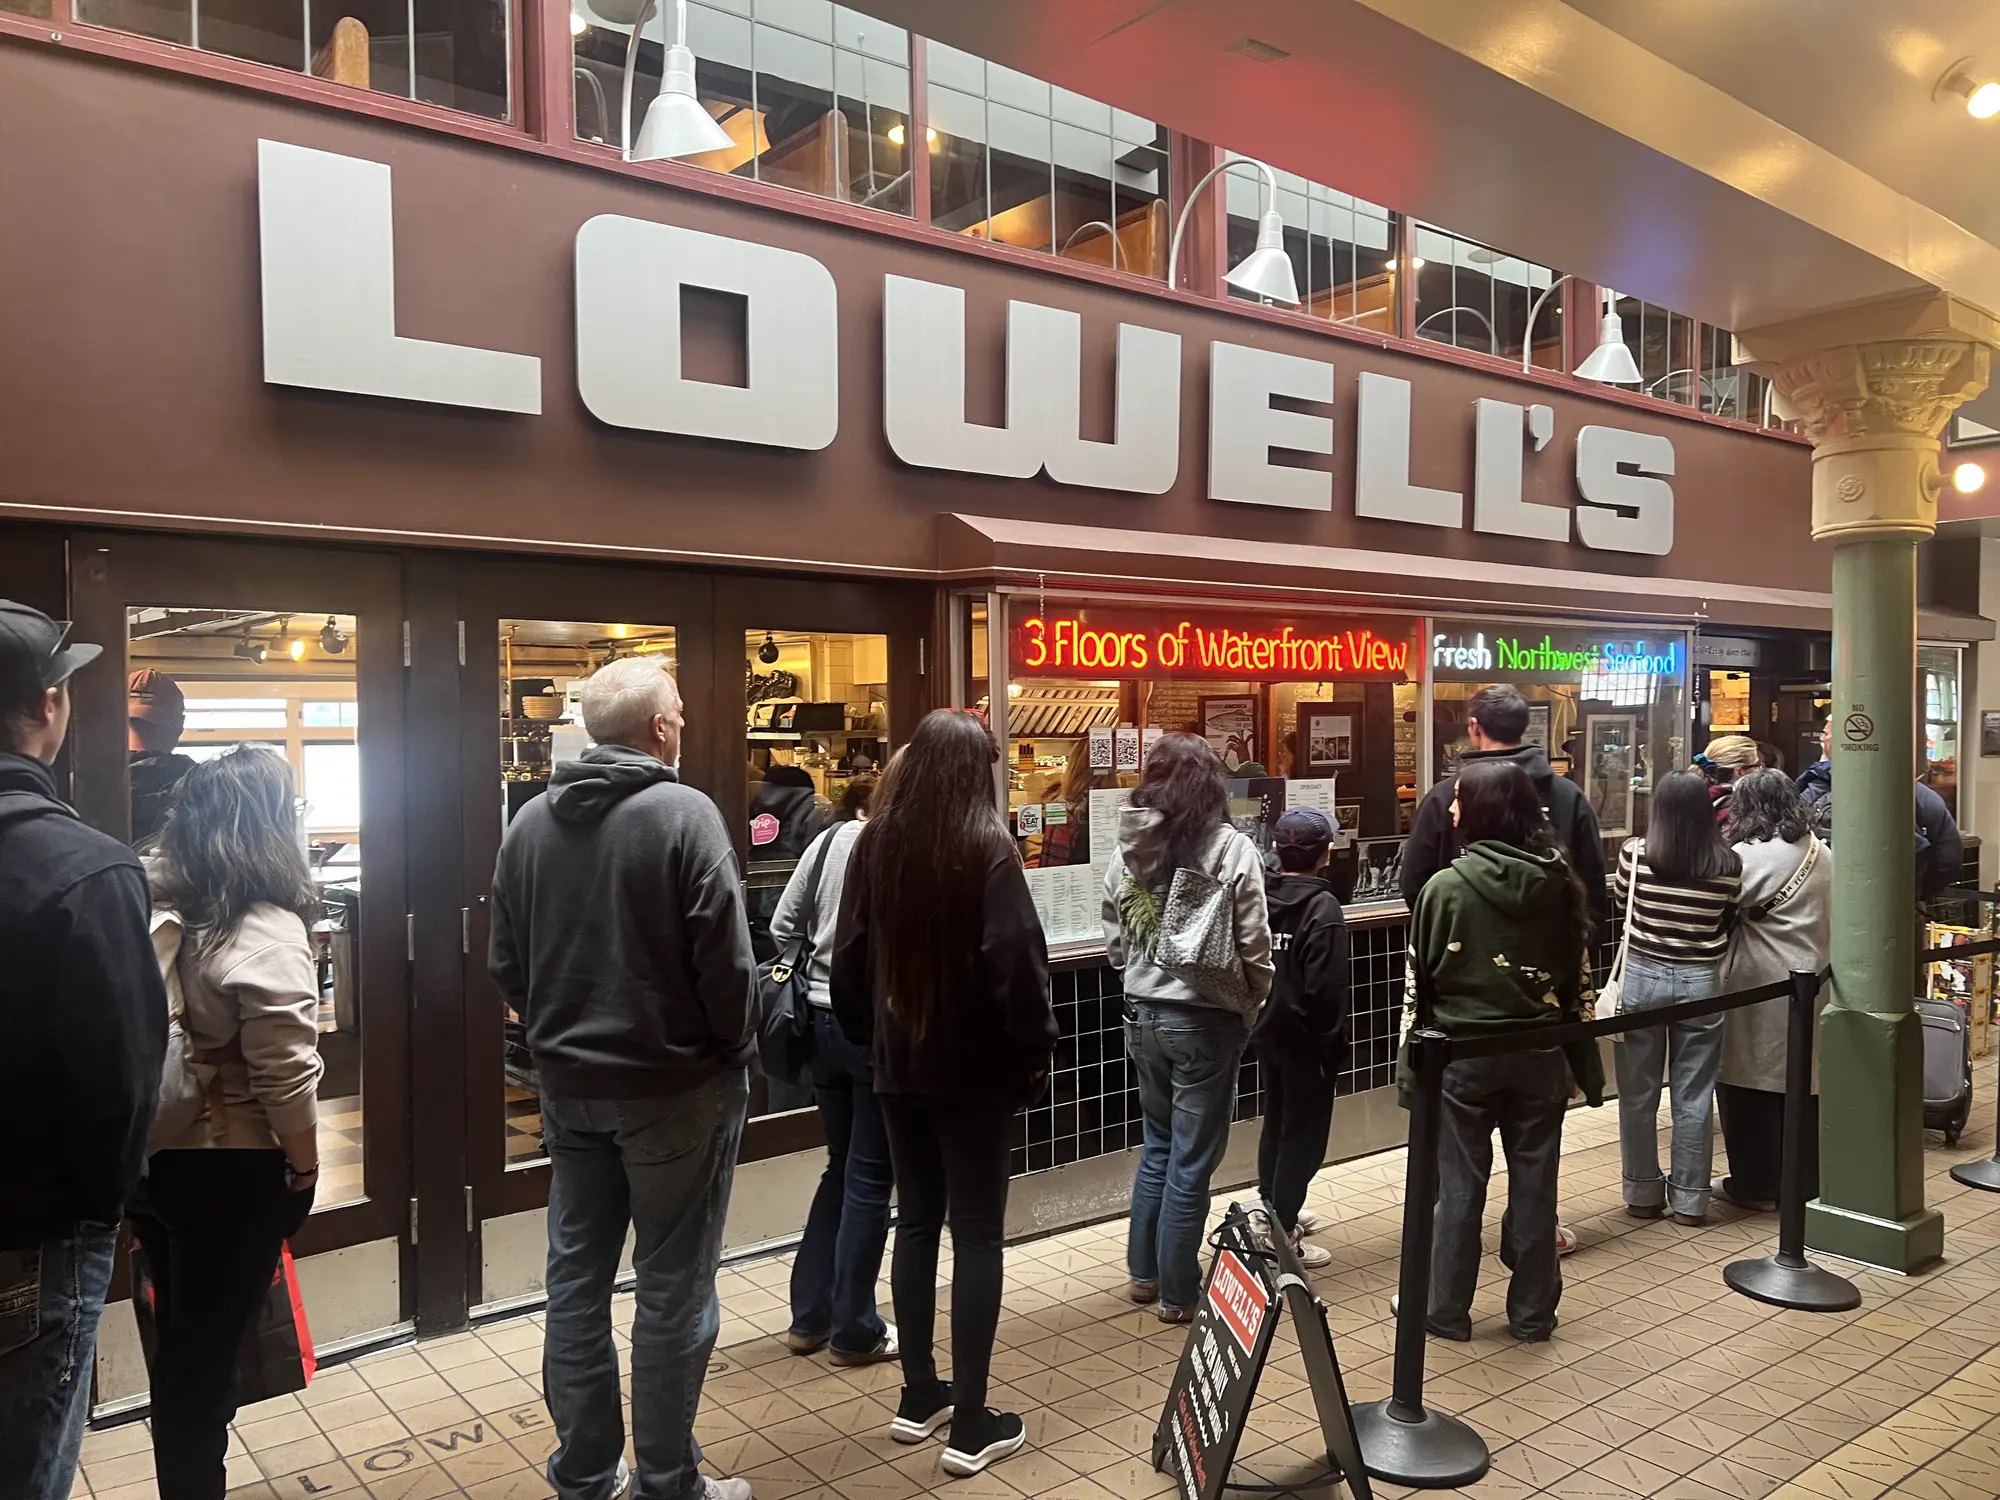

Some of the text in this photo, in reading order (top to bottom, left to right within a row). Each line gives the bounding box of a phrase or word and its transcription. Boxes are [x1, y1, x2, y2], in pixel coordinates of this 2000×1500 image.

[256, 138, 1676, 556] LOWELL'S
[1025, 619, 1408, 671] 3 Floors of Waterfront View
[1433, 632, 1676, 675] Fresh Northwest Seafood
[1851, 703, 1865, 712] NO
[1840, 743, 1880, 752] SMOKING
[1213, 1260, 1261, 1336] LOWELL'S
[1203, 1327, 1219, 1372] OPEN
[1211, 1351, 1229, 1401] DAILY
